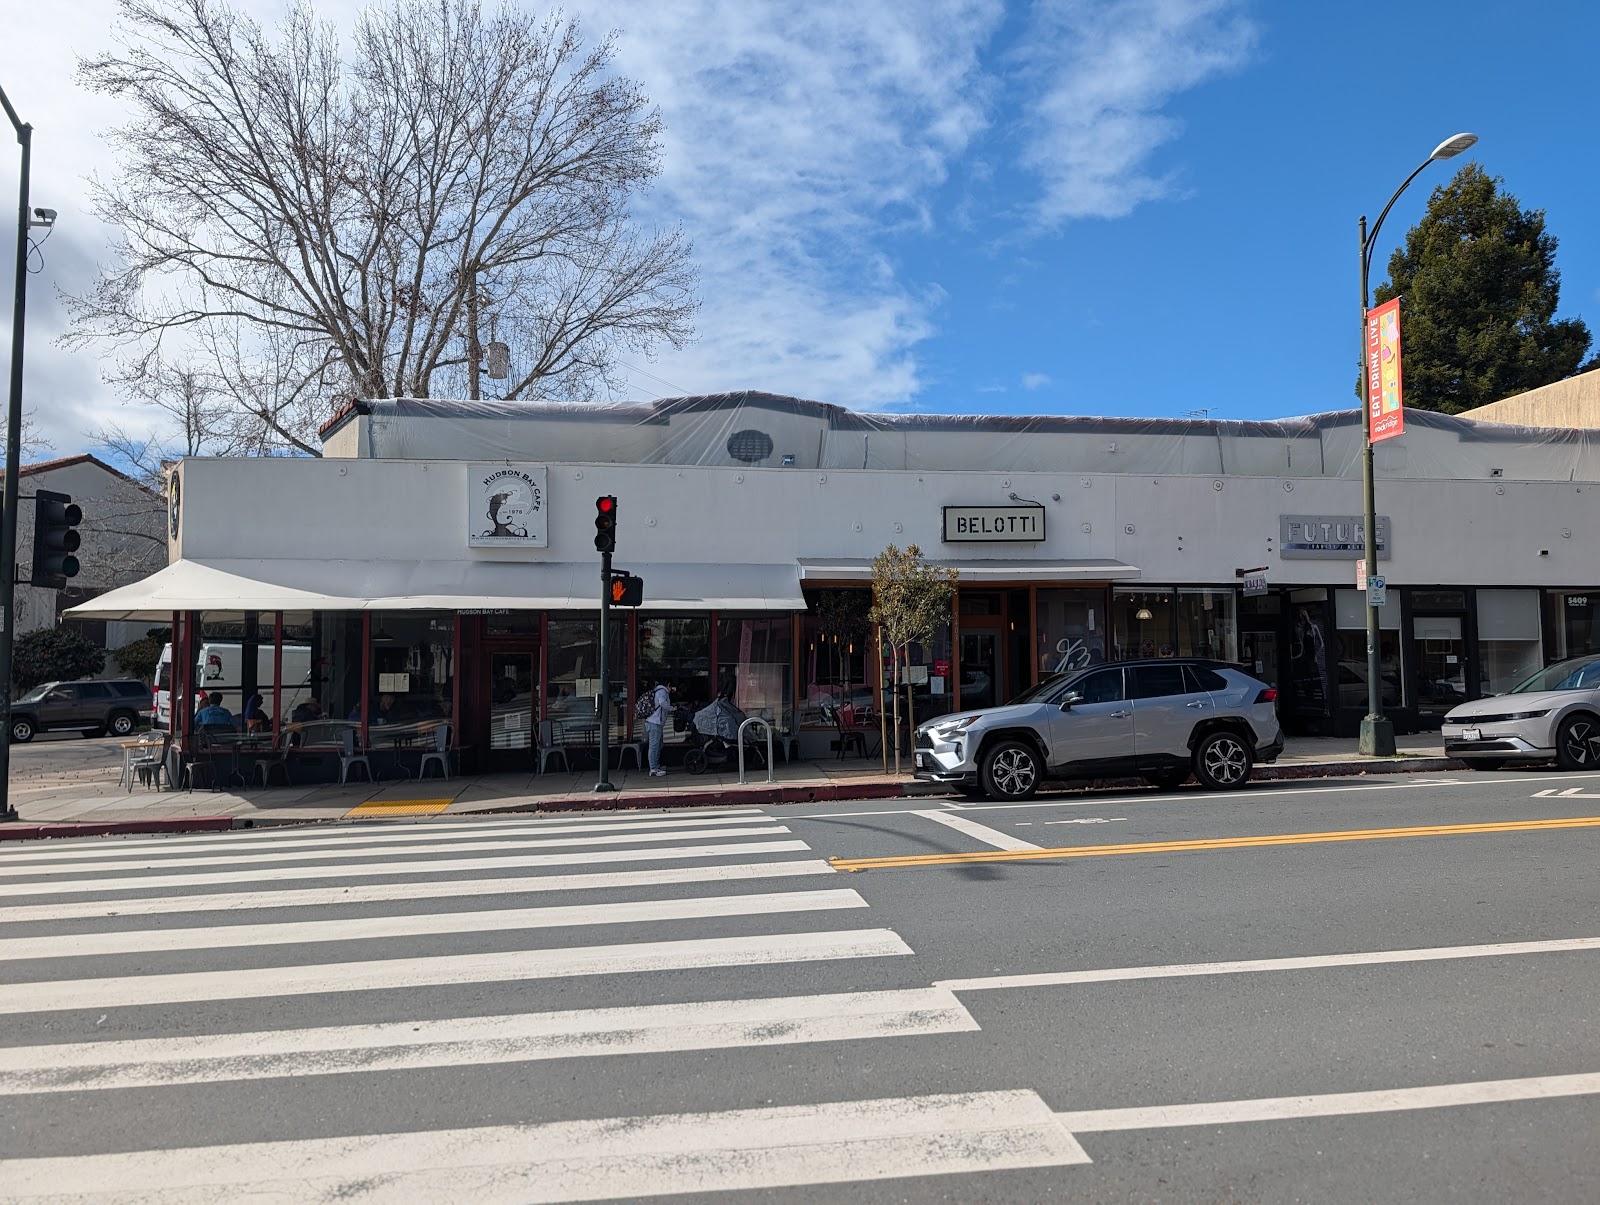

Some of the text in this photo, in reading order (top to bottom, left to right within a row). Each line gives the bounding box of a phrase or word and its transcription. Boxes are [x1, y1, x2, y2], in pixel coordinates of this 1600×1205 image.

[1370, 317, 1380, 418] EAT DRINK LIVE
[483, 470, 541, 512] HUDSON BAY CAFE
[957, 516, 1036, 533] BELOTTI
[1288, 523, 1385, 543] FUTURE
